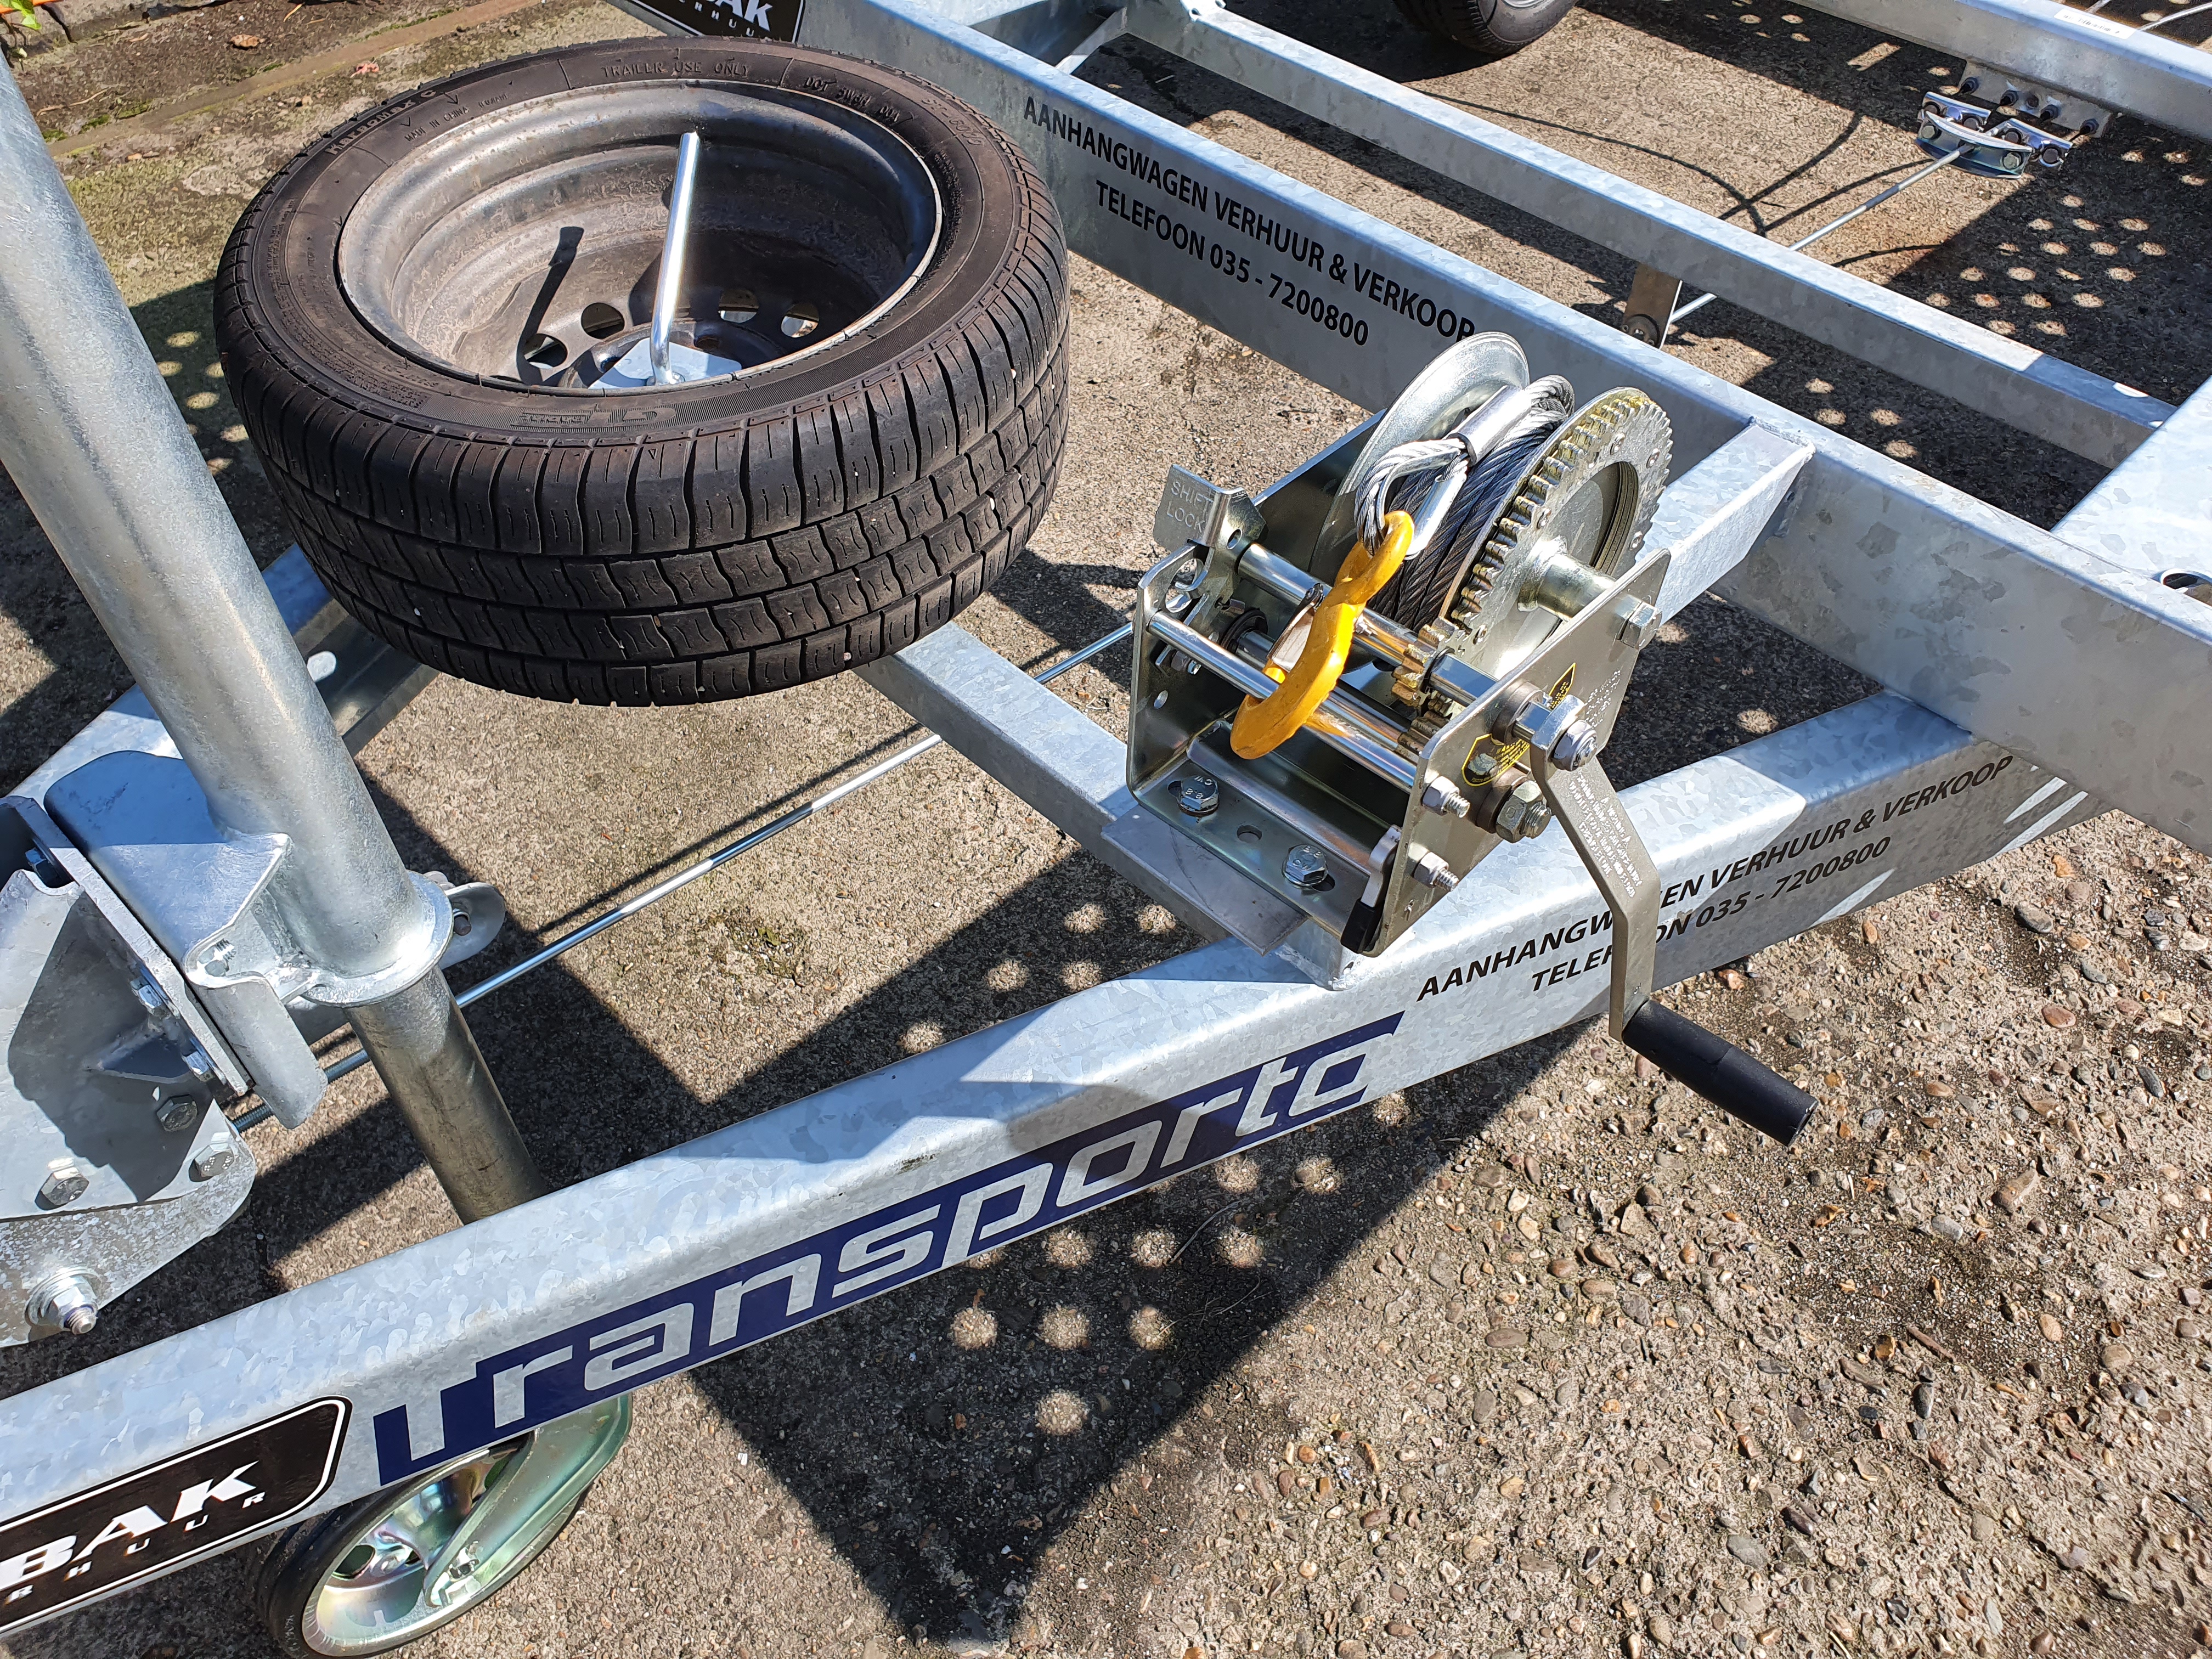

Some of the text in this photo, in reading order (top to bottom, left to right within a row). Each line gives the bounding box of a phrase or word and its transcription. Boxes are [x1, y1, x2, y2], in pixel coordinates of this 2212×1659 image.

[443, 106, 470, 122] CHINA
[675, 61, 702, 76] USE
[714, 63, 750, 78] ONLY
[1024, 96, 1475, 342] AANHANGWAGEN VERHUUR & VERKOOP
[1096, 179, 1205, 261] TELEFOON
[1210, 244, 1251, 283] 035
[1268, 272, 1369, 346] 7200800
[1166, 500, 1207, 534] LOCK
[1695, 890, 1752, 929] 035
[1769, 836, 1891, 900] 7200800
[1711, 818, 1852, 889] VERHUUR
[1852, 809, 1879, 834] &
[1882, 755, 2014, 823] VERKOOP
[392, 1019, 1398, 1472] Transporta
[0, 1460, 259, 1592] BAK
